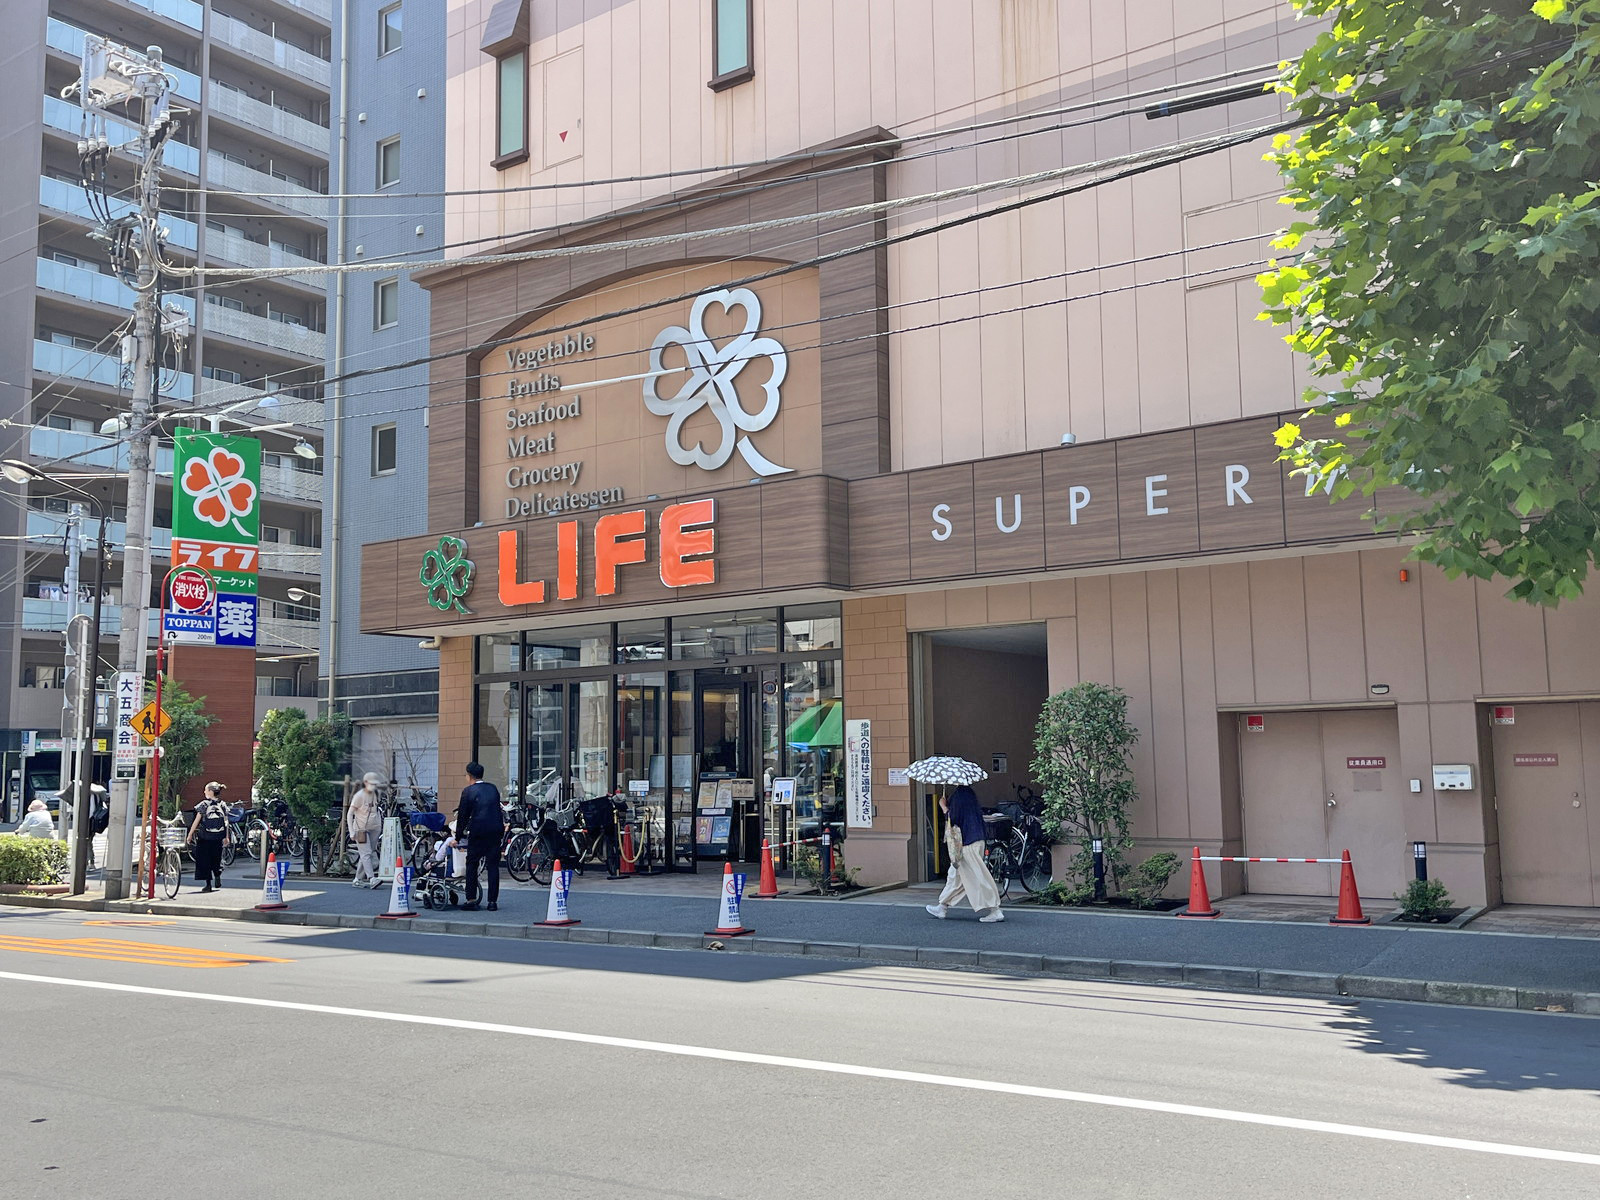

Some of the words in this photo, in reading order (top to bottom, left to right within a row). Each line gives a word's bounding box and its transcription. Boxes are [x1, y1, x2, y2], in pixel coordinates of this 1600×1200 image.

[505, 331, 594, 369] Vegetable
[506, 371, 561, 399] Fruits
[505, 395, 581, 430] Seafood
[506, 431, 555, 459] Meat
[505, 459, 583, 490] Grocery
[504, 486, 624, 519] Delicatessen
[930, 464, 1254, 542] SUPER
[178, 543, 256, 570] ライフ
[498, 498, 718, 606] LIFE
[174, 581, 206, 600] 消火栓
[204, 574, 255, 588] ーマーケット
[167, 617, 213, 629] TOPPAN
[218, 600, 254, 639] 薬
[119, 678, 133, 745] 大五商会
